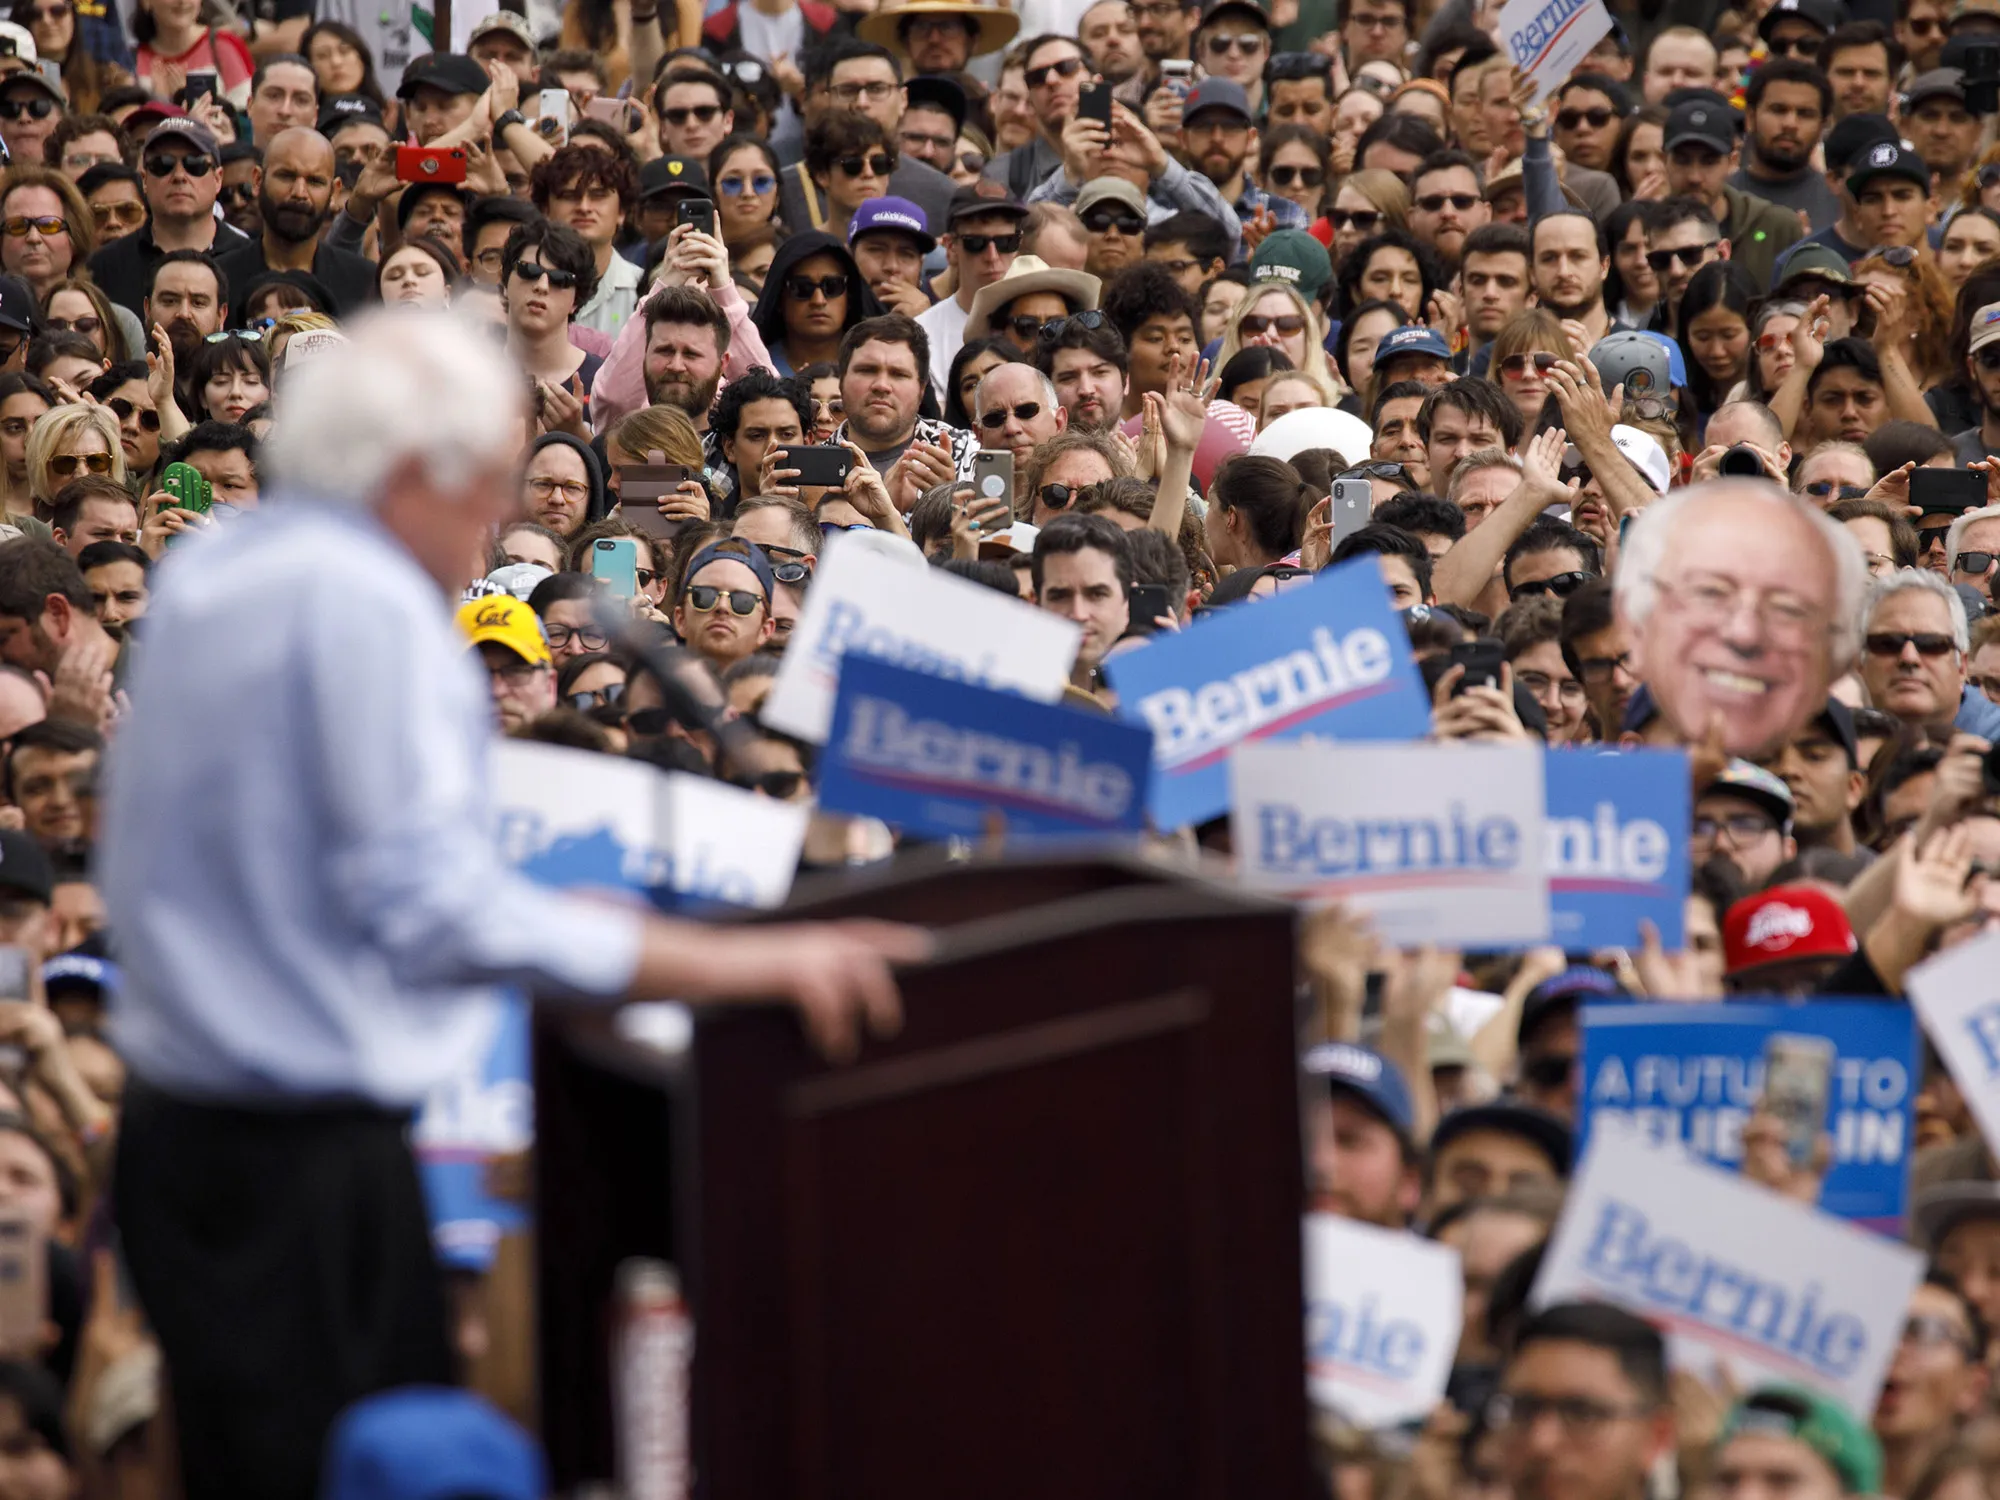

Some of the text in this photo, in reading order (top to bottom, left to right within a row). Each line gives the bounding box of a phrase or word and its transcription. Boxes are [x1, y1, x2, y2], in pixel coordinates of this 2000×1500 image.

[475, 603, 513, 626] Cal
[1139, 624, 1393, 765] Bernie
[838, 696, 1134, 822] Bernie
[1256, 802, 1525, 876] Bernie
[1546, 803, 1670, 881] nie
[1591, 1055, 1909, 1108] A FUTU TO
[1836, 1110, 1905, 1166] IN
[1583, 1198, 1867, 1379] Bernie
